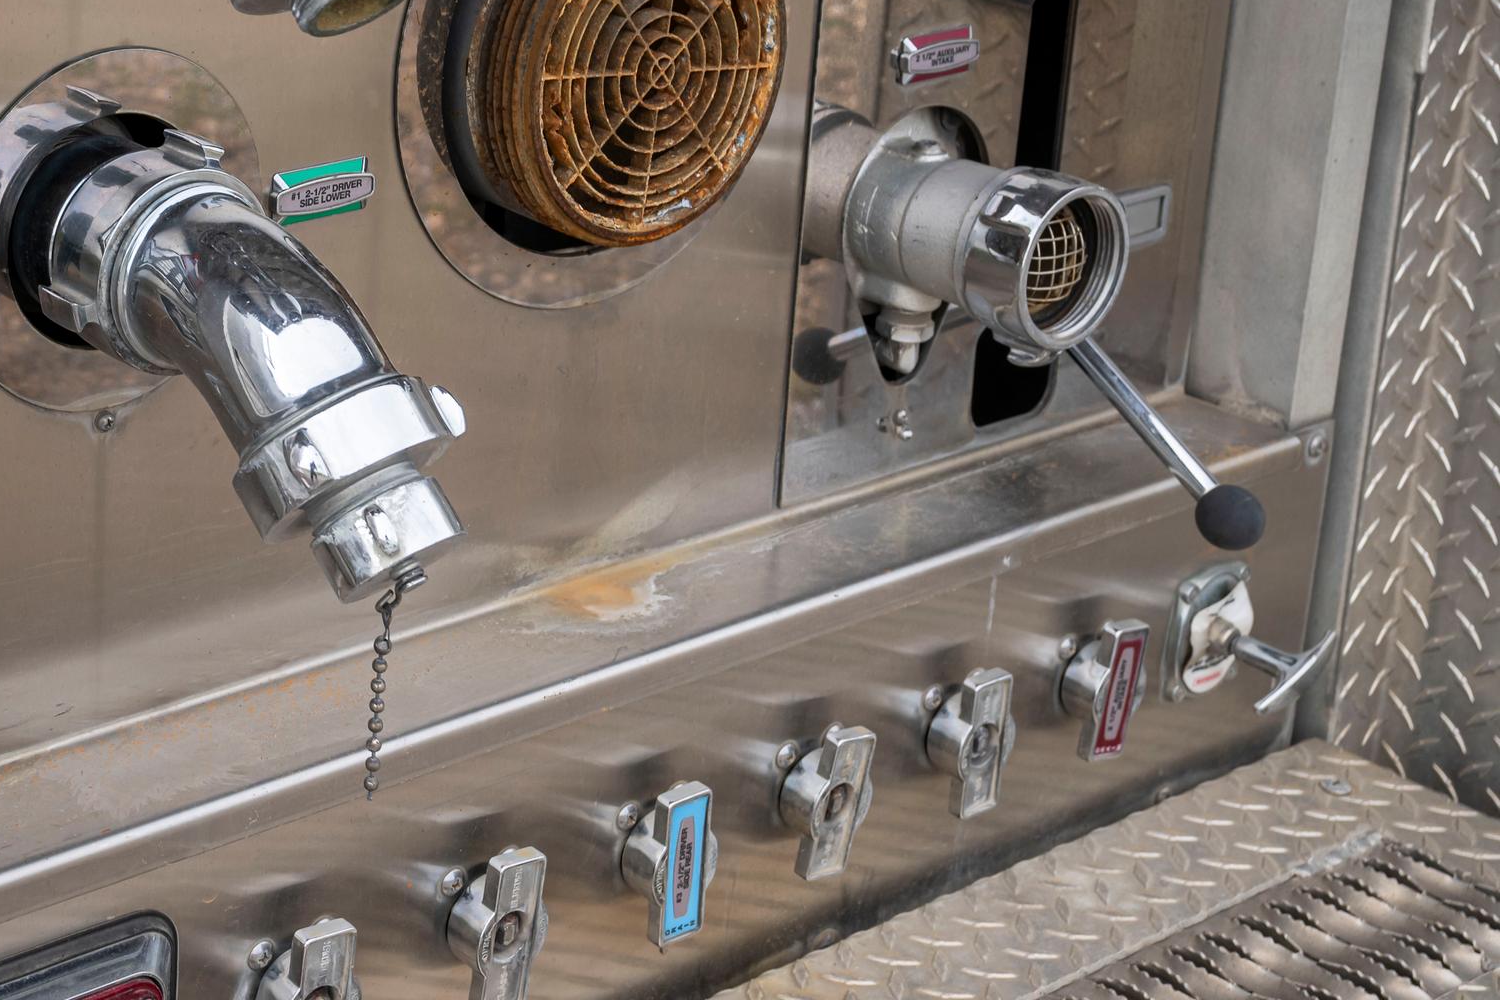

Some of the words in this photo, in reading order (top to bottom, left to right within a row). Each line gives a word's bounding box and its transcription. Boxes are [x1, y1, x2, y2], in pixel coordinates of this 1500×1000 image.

[291, 193, 300, 201] #1
[305, 186, 331, 198] 2-1/2"
[332, 179, 363, 193] DRIVER
[299, 197, 319, 208] SIDE
[321, 190, 351, 203] LOWER
